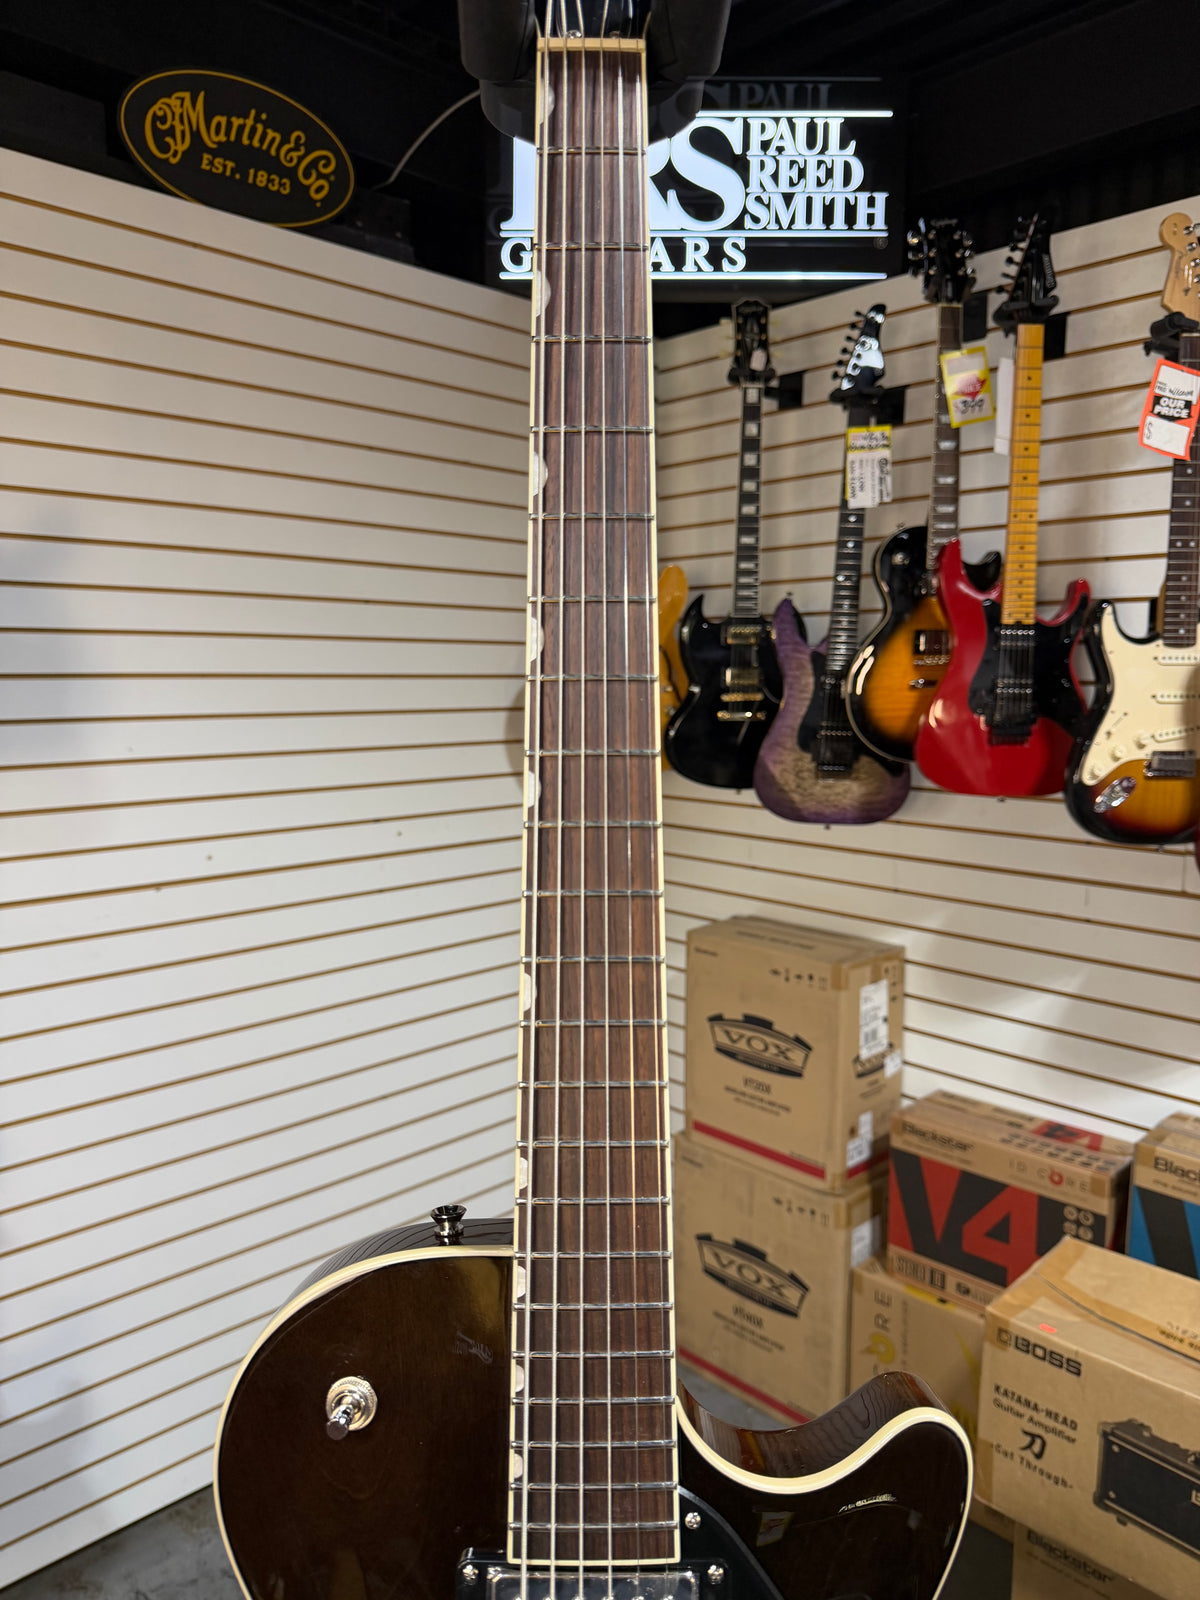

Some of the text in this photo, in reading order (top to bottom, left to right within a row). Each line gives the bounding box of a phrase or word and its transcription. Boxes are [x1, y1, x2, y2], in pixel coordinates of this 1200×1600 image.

[746, 118, 857, 156] PAUL
[201, 153, 292, 195] EST. 1833
[746, 155, 864, 193] REED
[745, 191, 889, 231] SMITH
[500, 237, 746, 272] GARS
[1152, 403, 1191, 419] PRICE
[1160, 396, 1186, 409] OUR
[721, 1028, 797, 1063] VOX
[901, 1120, 975, 1152] Blackstar
[710, 1251, 792, 1300] VOX
[1014, 1334, 1082, 1378] BOSS
[993, 1383, 1078, 1432] KATANA-HEAD
[993, 1398, 1077, 1444] Guitar Amplifier
[1026, 1528, 1114, 1583] Blackstar
